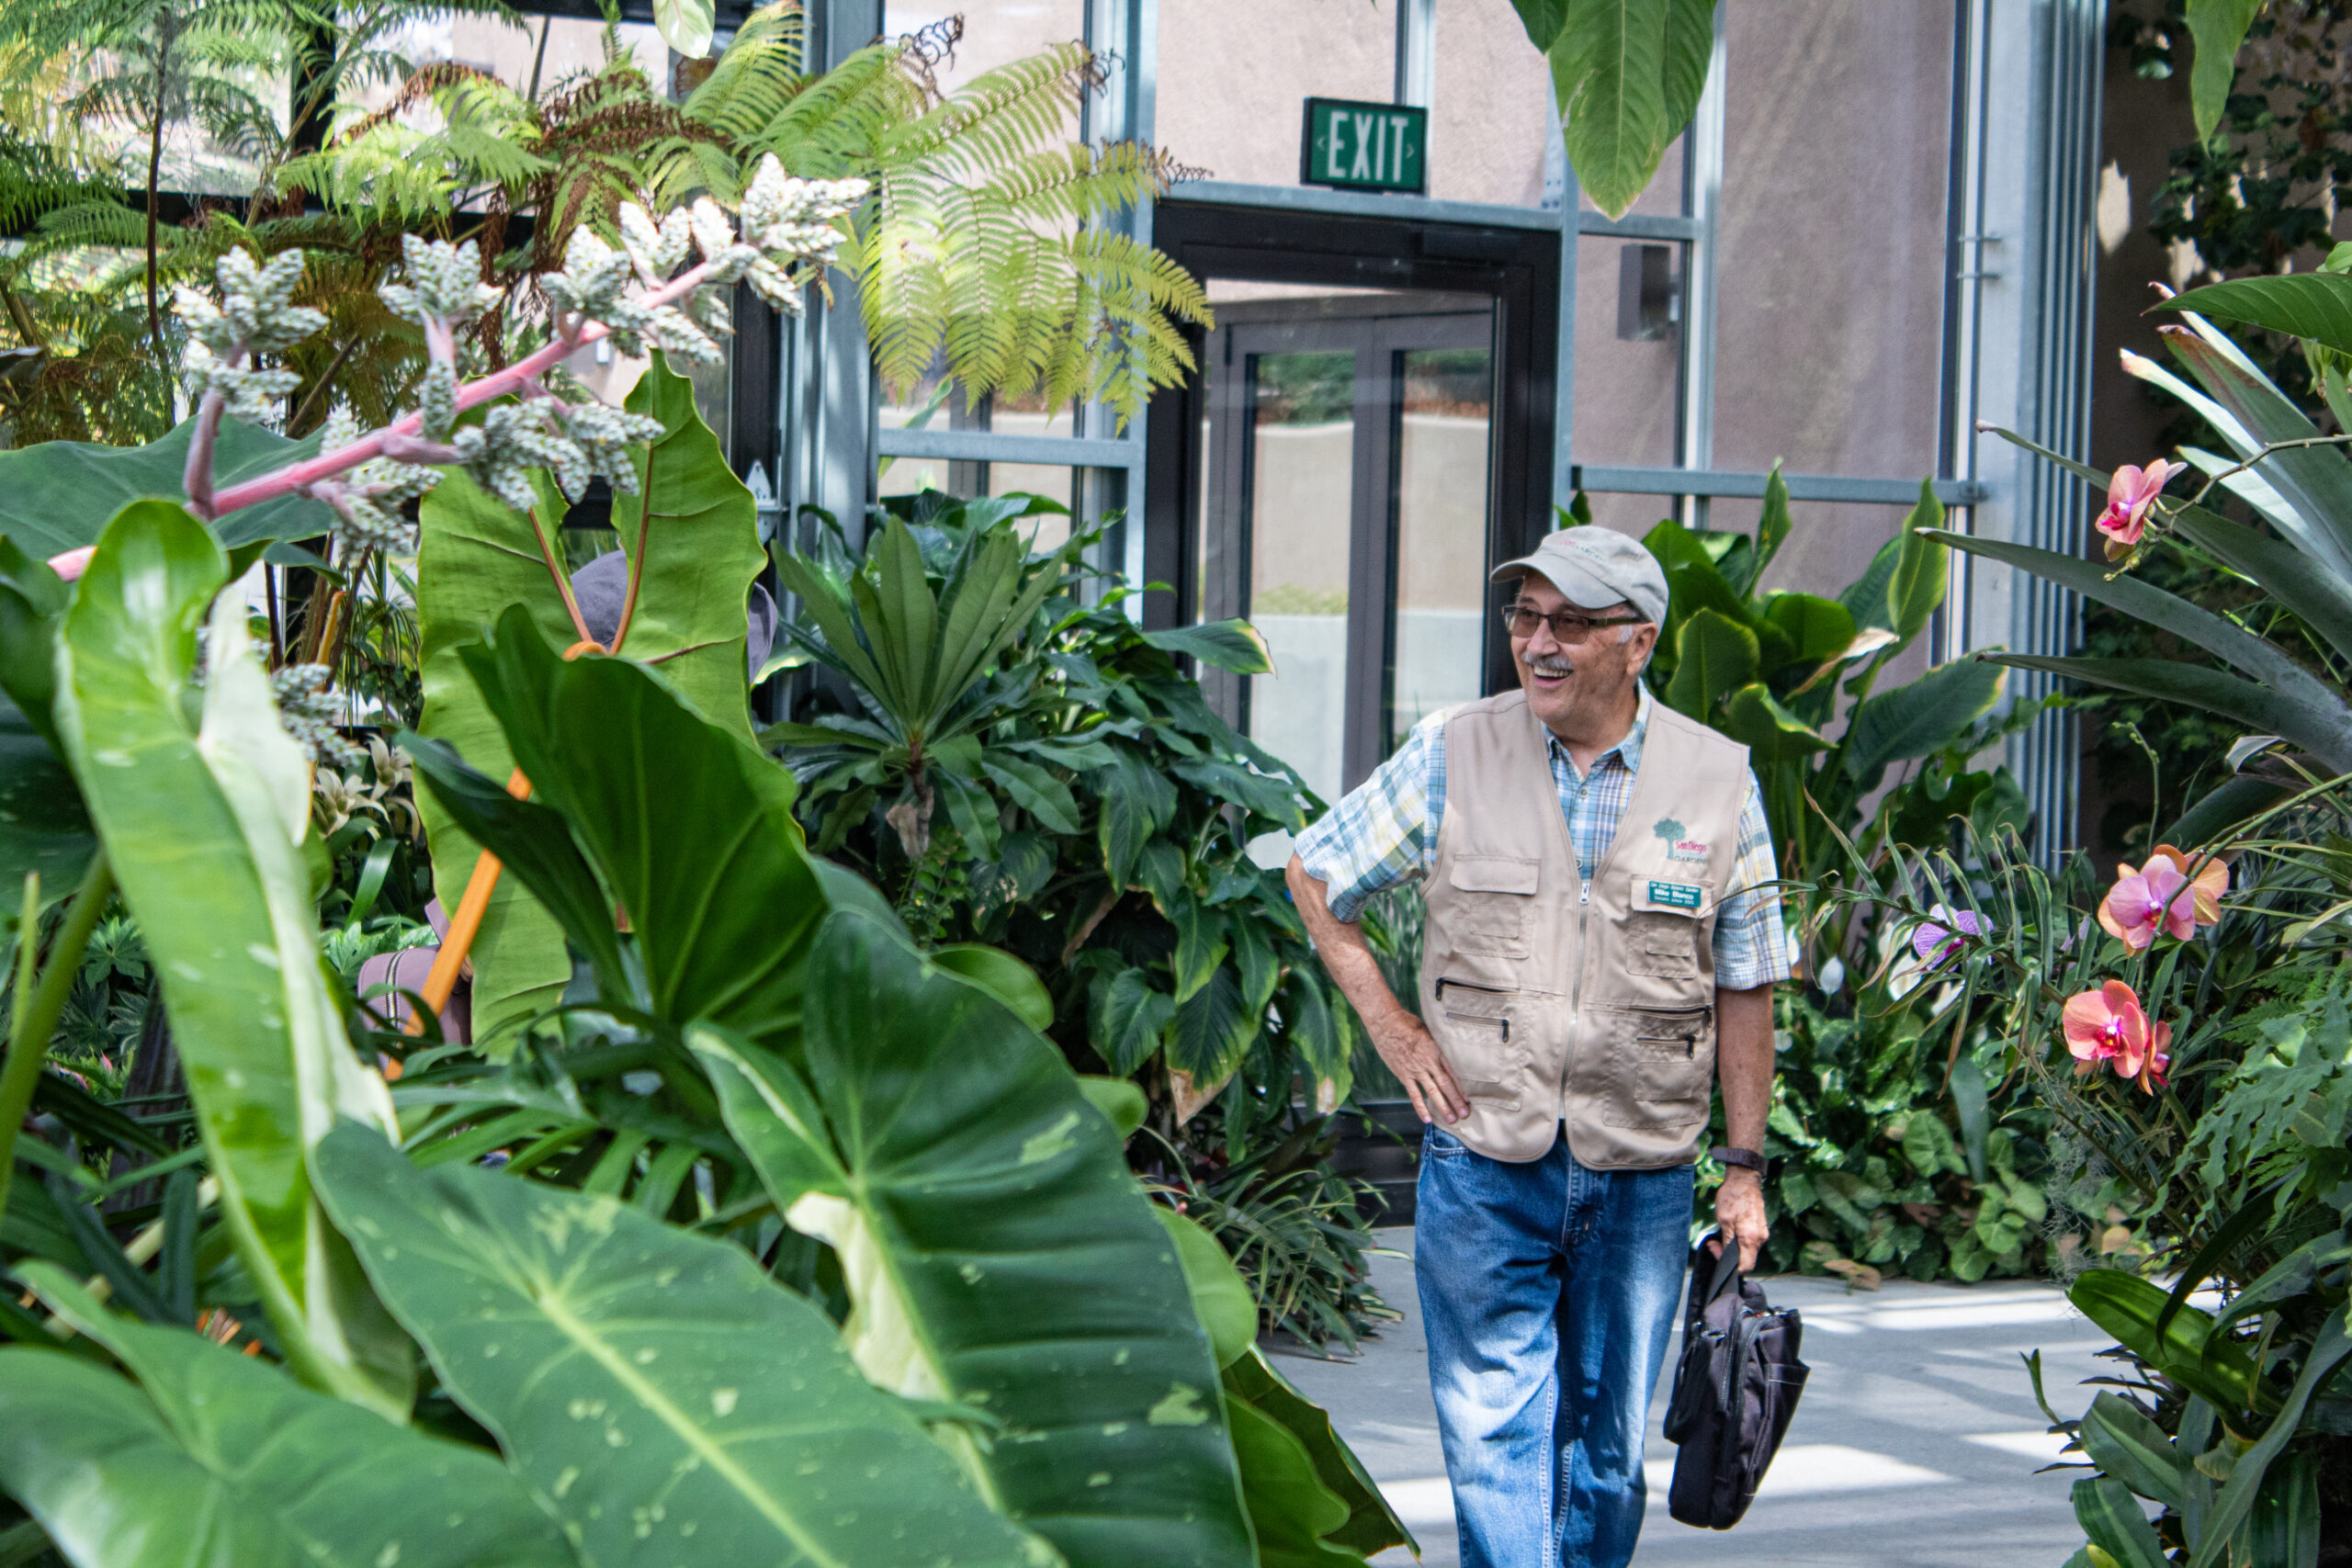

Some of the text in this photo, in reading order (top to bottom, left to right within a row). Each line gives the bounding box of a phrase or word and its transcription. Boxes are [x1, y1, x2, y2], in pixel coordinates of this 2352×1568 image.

[1328, 111, 1408, 183] EXIT
[1675, 840, 1707, 853] San Diego
[1674, 855, 1707, 864] GARDEN
[1672, 891, 1694, 899] Blanco
